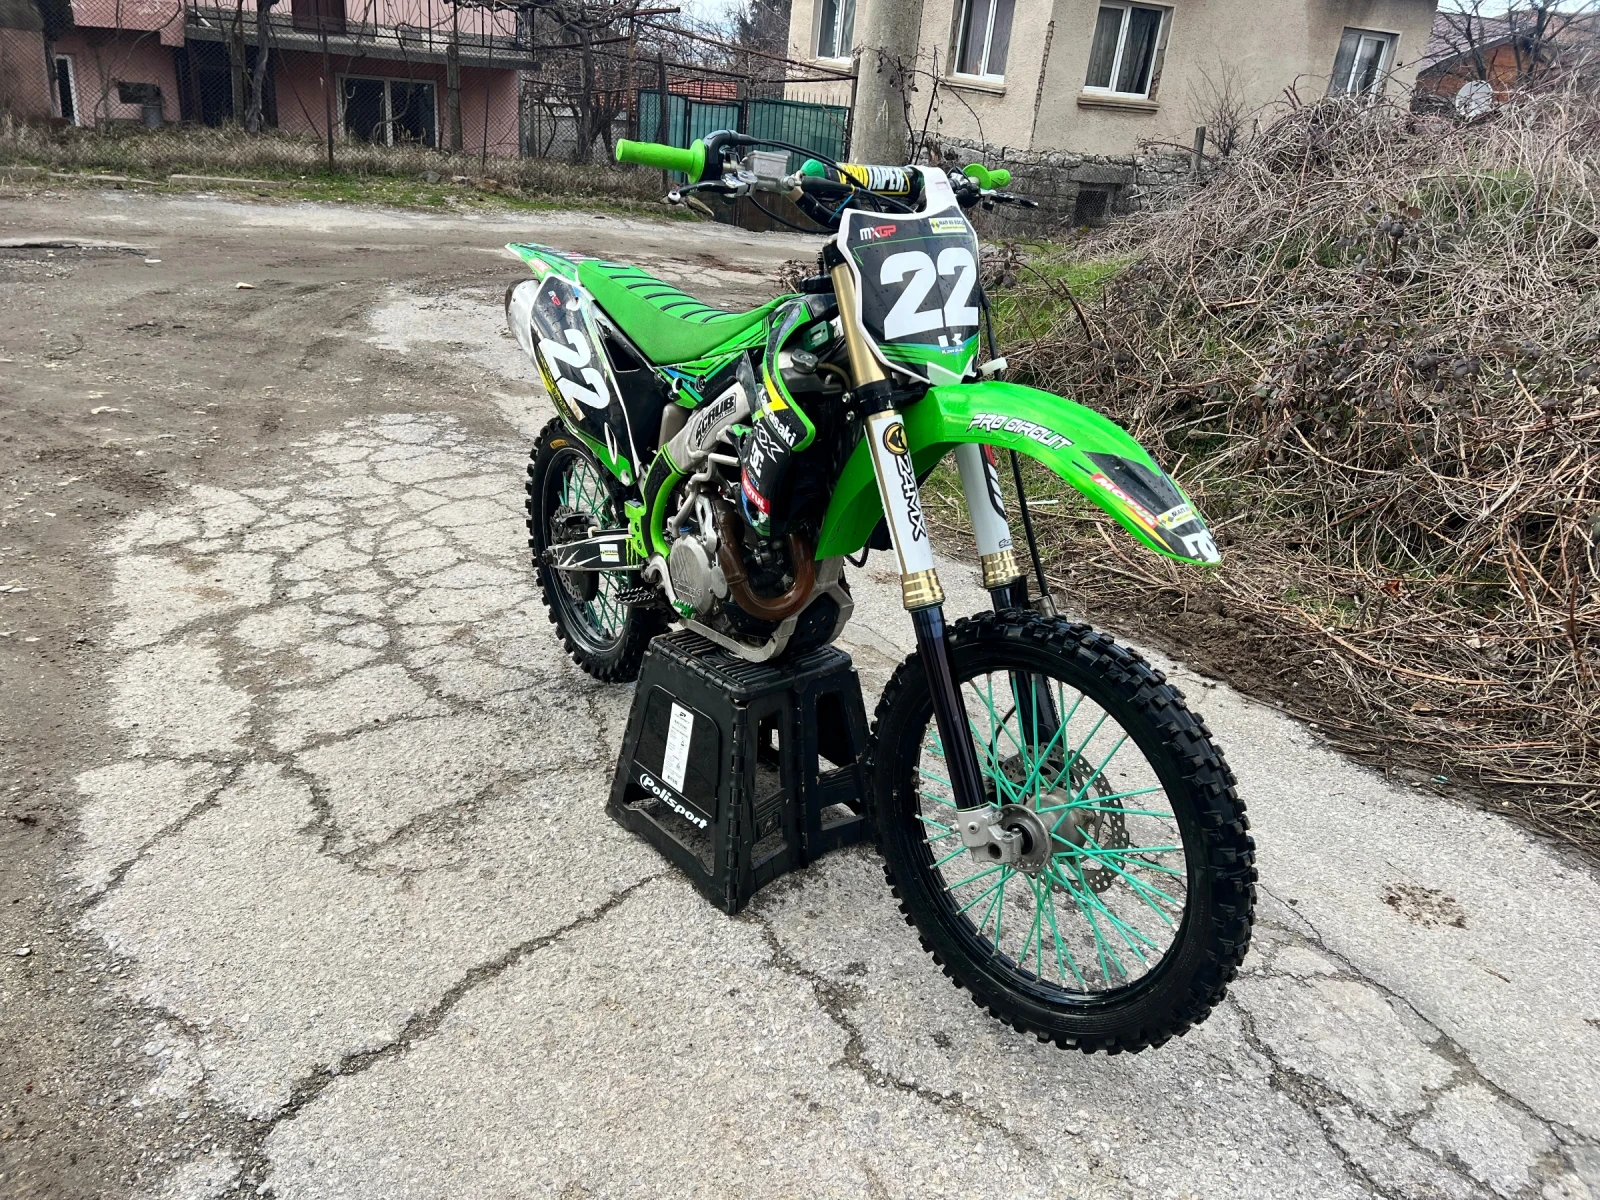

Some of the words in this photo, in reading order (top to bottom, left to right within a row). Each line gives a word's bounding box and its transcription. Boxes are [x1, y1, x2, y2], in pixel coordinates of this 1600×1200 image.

[860, 224, 897, 241] MXGP
[880, 247, 978, 340] 22
[538, 328, 611, 422] 22
[966, 413, 1009, 433] PRO
[1003, 417, 1075, 450] CIRCUIT
[642, 775, 708, 829] Polisport
